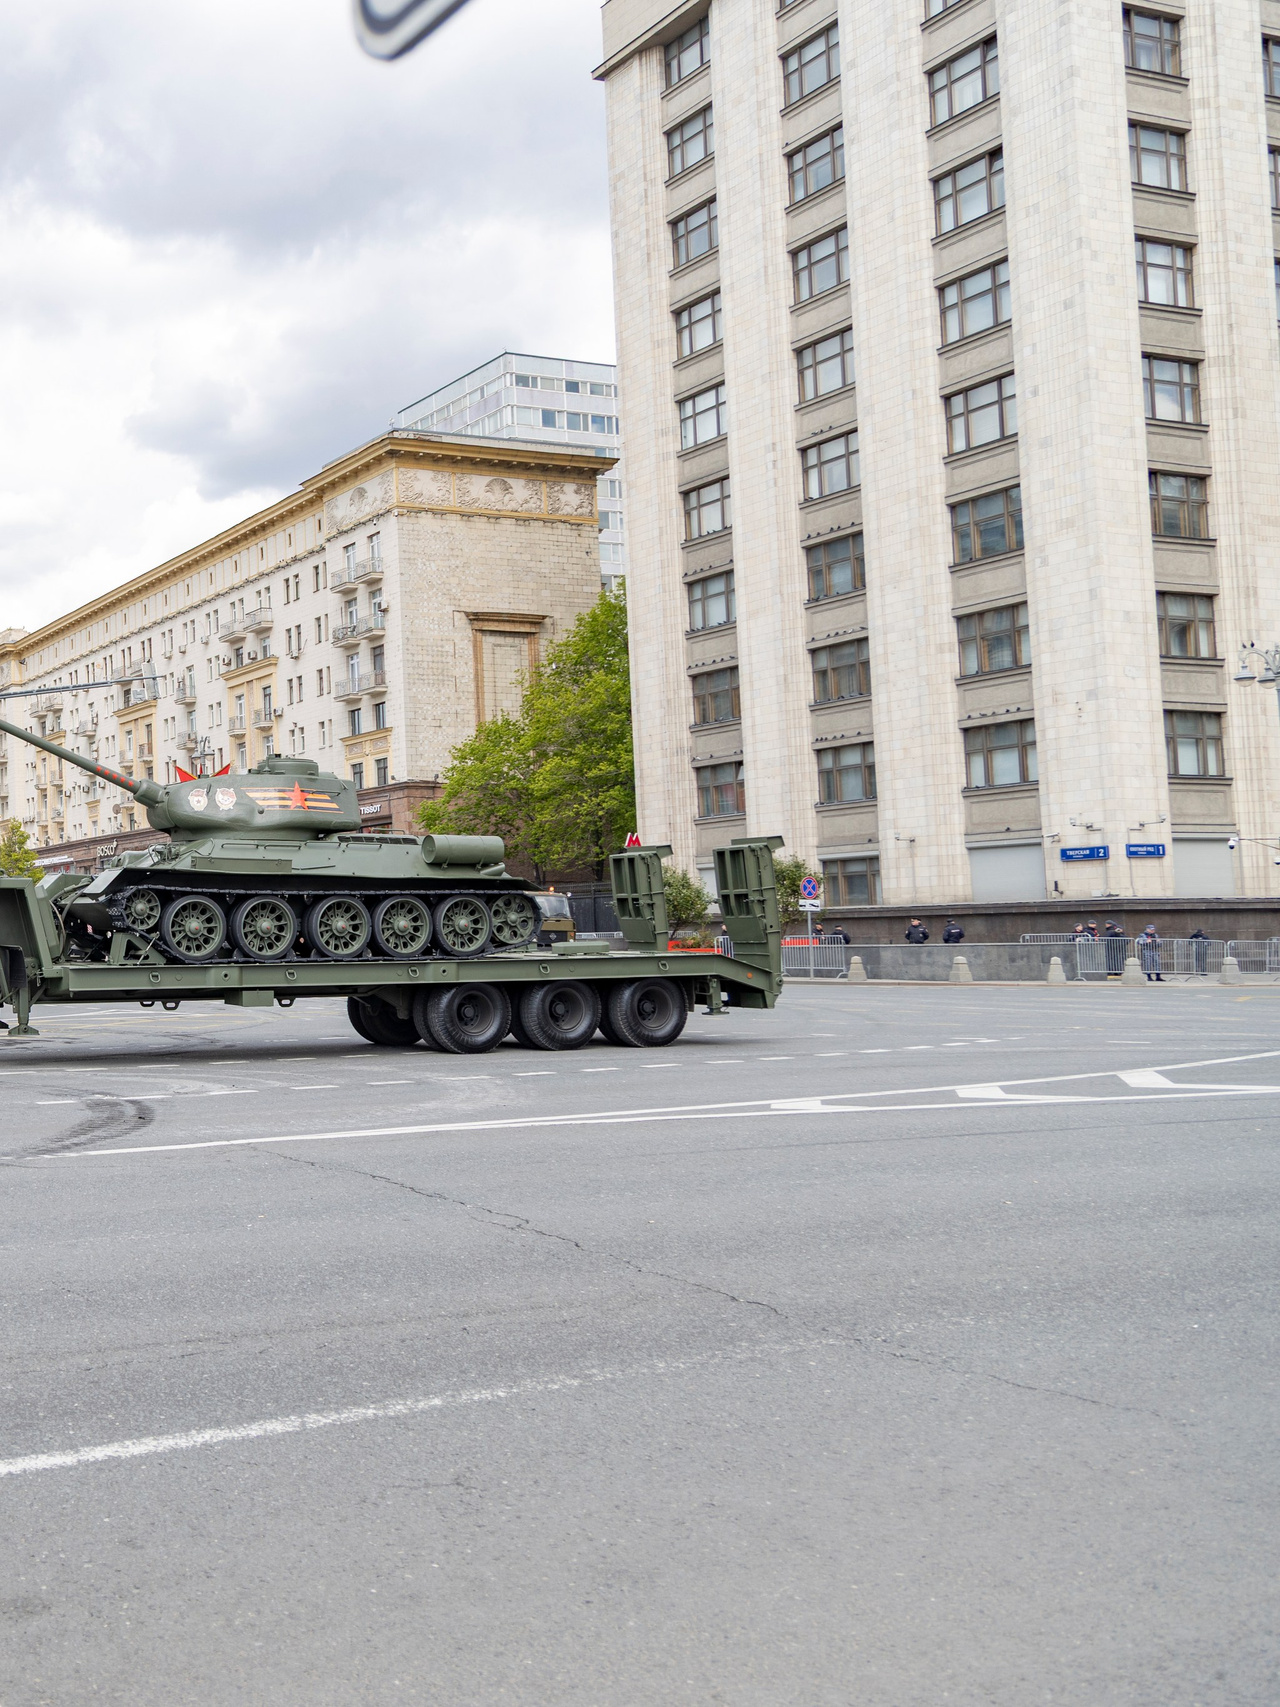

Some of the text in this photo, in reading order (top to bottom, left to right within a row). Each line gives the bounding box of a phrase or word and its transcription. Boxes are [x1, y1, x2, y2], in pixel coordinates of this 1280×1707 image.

[360, 805, 381, 815] TISSOT
[96, 844, 115, 857] BOSCO
[1098, 848, 1105, 857] 2
[1158, 846, 1163, 855] 1
